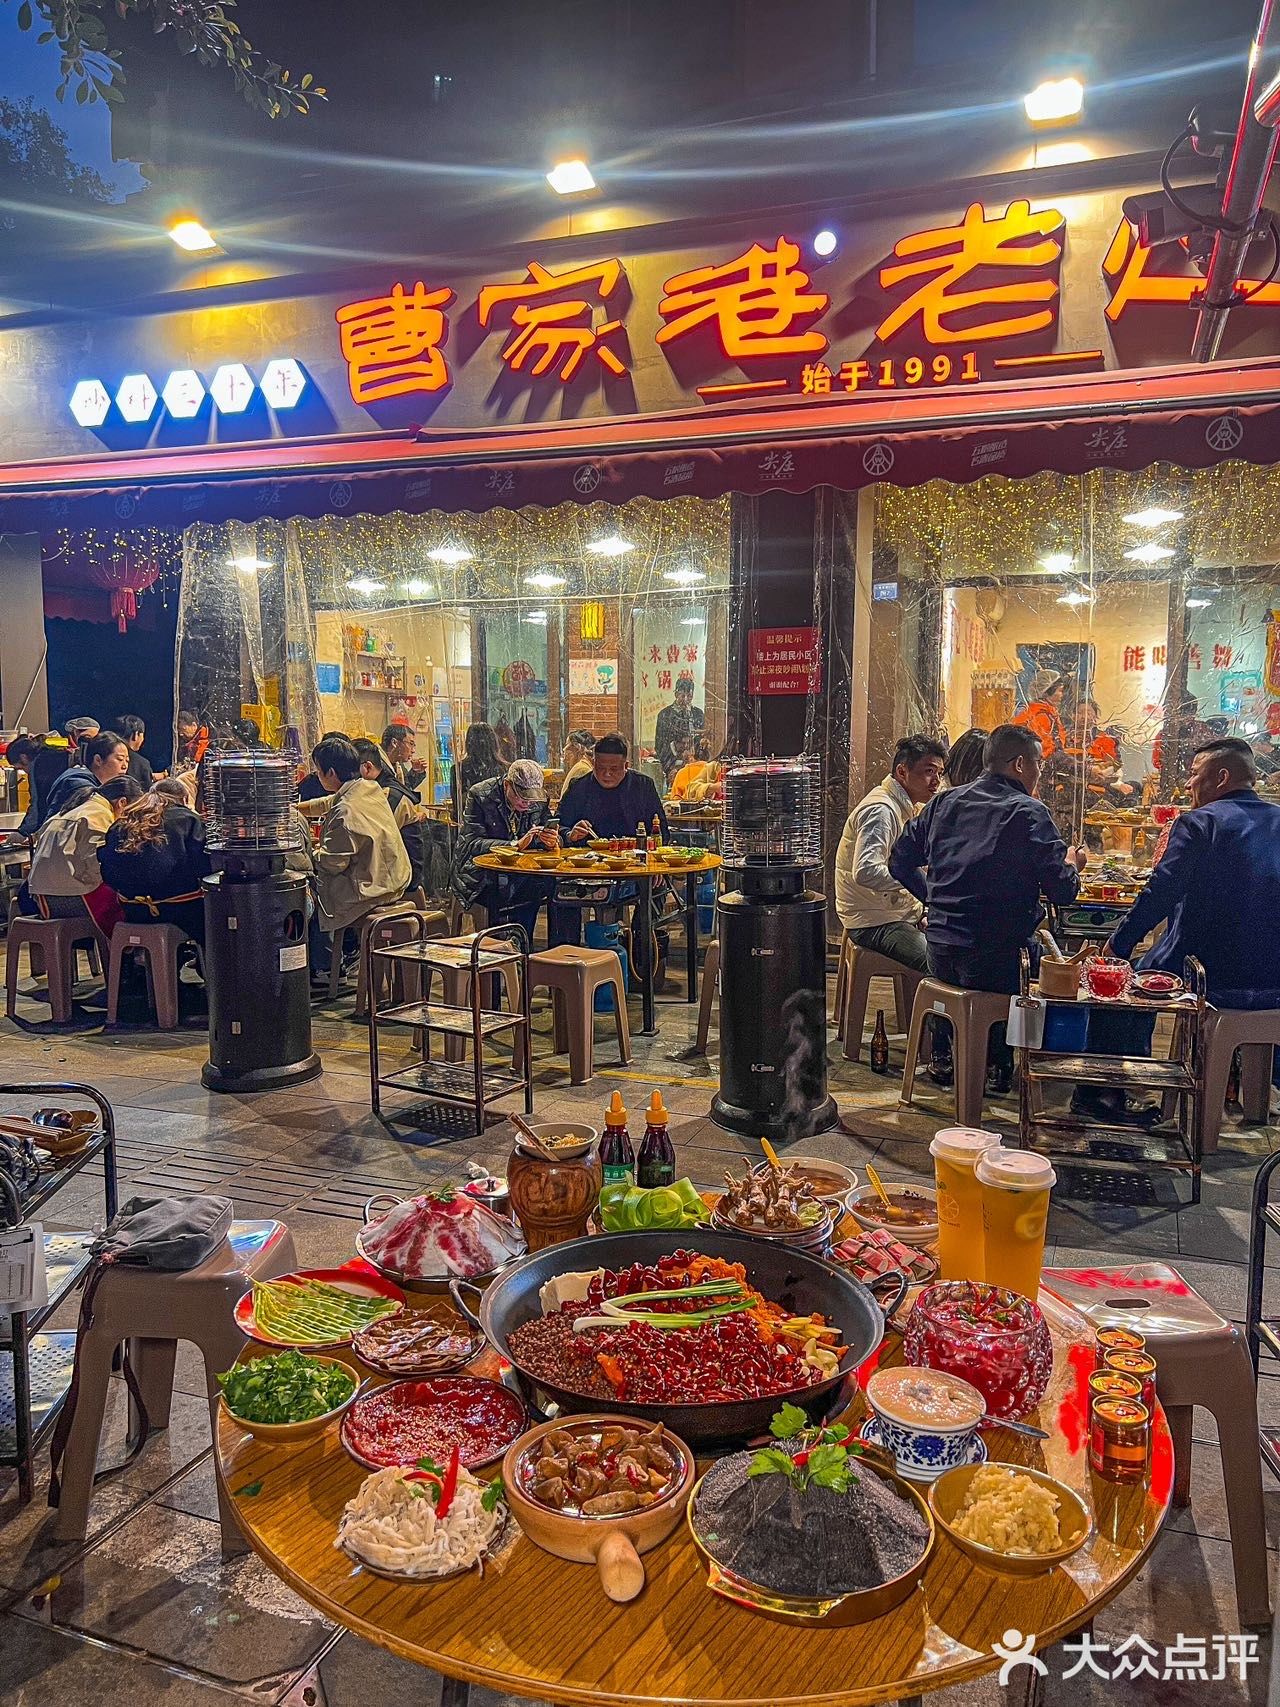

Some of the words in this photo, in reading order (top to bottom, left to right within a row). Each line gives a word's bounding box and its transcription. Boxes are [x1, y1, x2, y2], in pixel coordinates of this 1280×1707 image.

[801, 352, 980, 395] 始于1991
[1084, 426, 1128, 453] 尖庄
[758, 451, 796, 475] 尖庄
